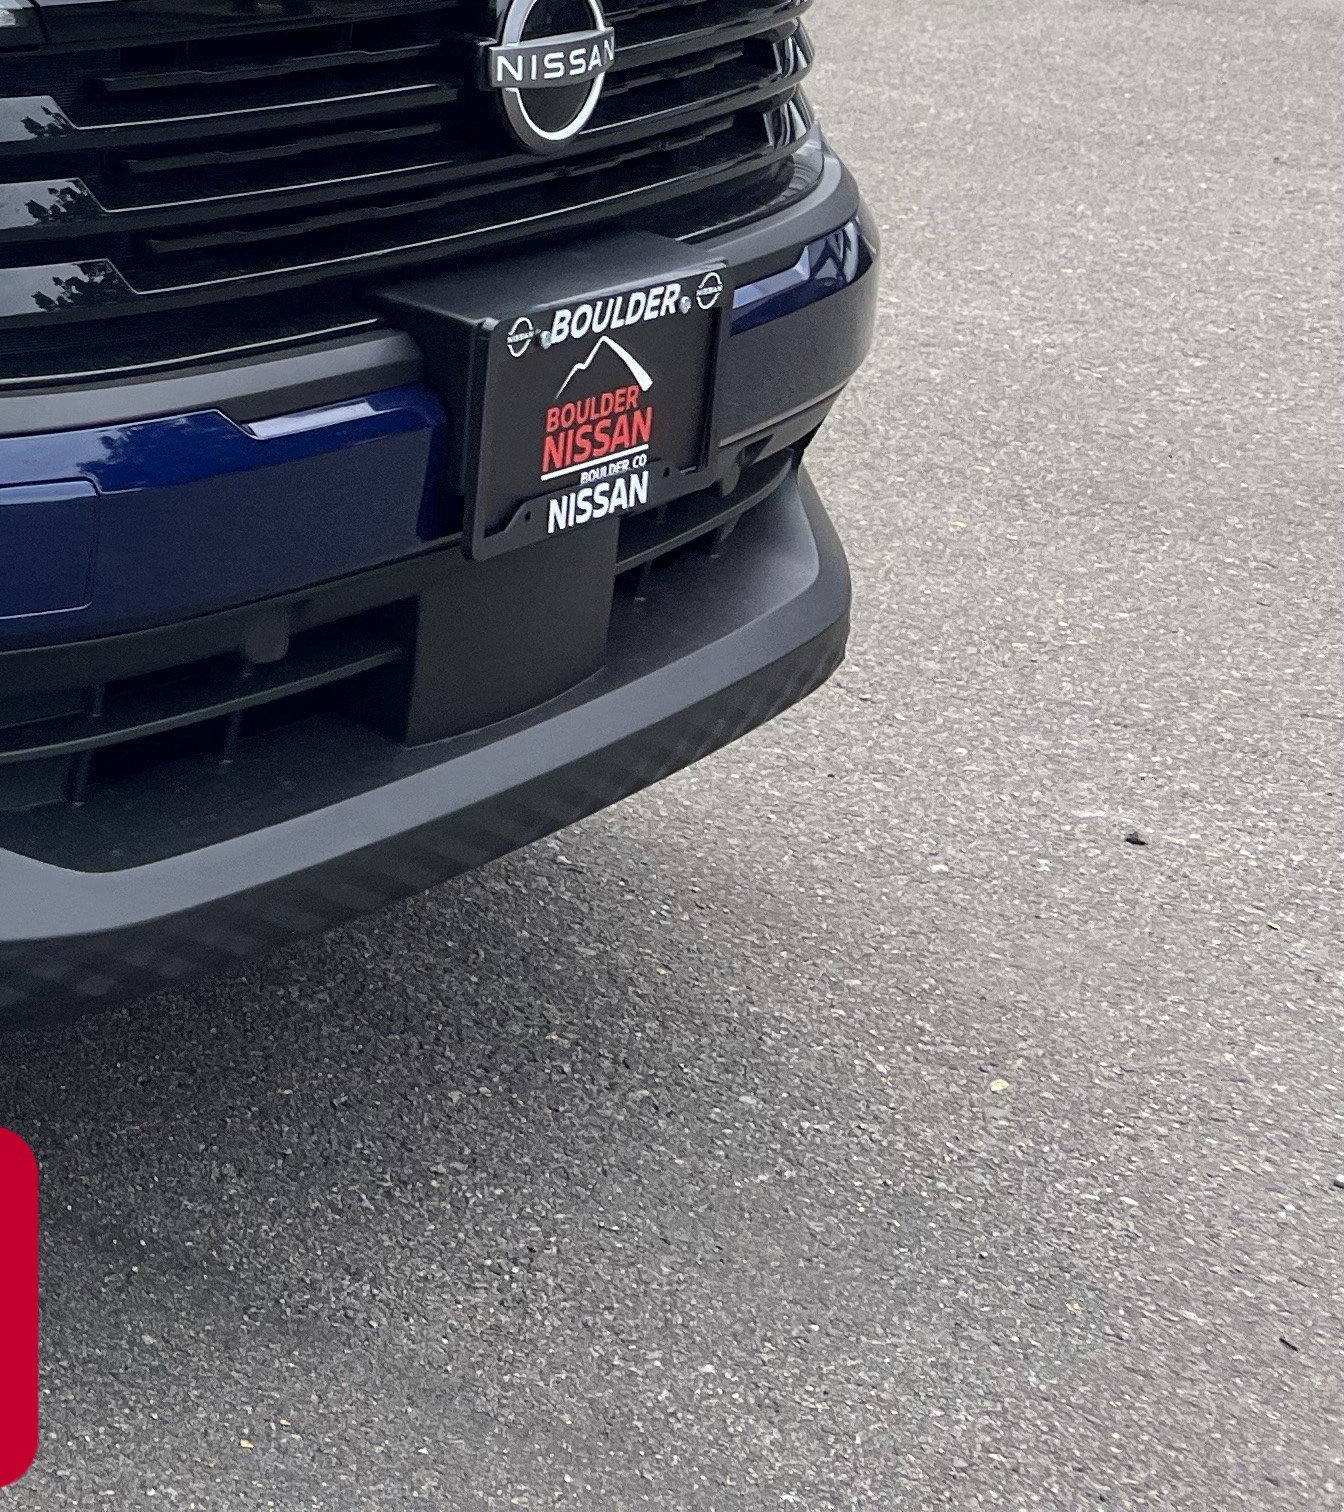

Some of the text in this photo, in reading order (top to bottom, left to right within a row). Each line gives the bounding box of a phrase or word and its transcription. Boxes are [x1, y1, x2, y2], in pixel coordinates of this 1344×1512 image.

[496, 39, 614, 82] NISSAN
[550, 283, 681, 344] BOULDER
[546, 384, 640, 433] BOULDER
[541, 406, 653, 473] NISSAN
[547, 470, 649, 534] NISSAN
